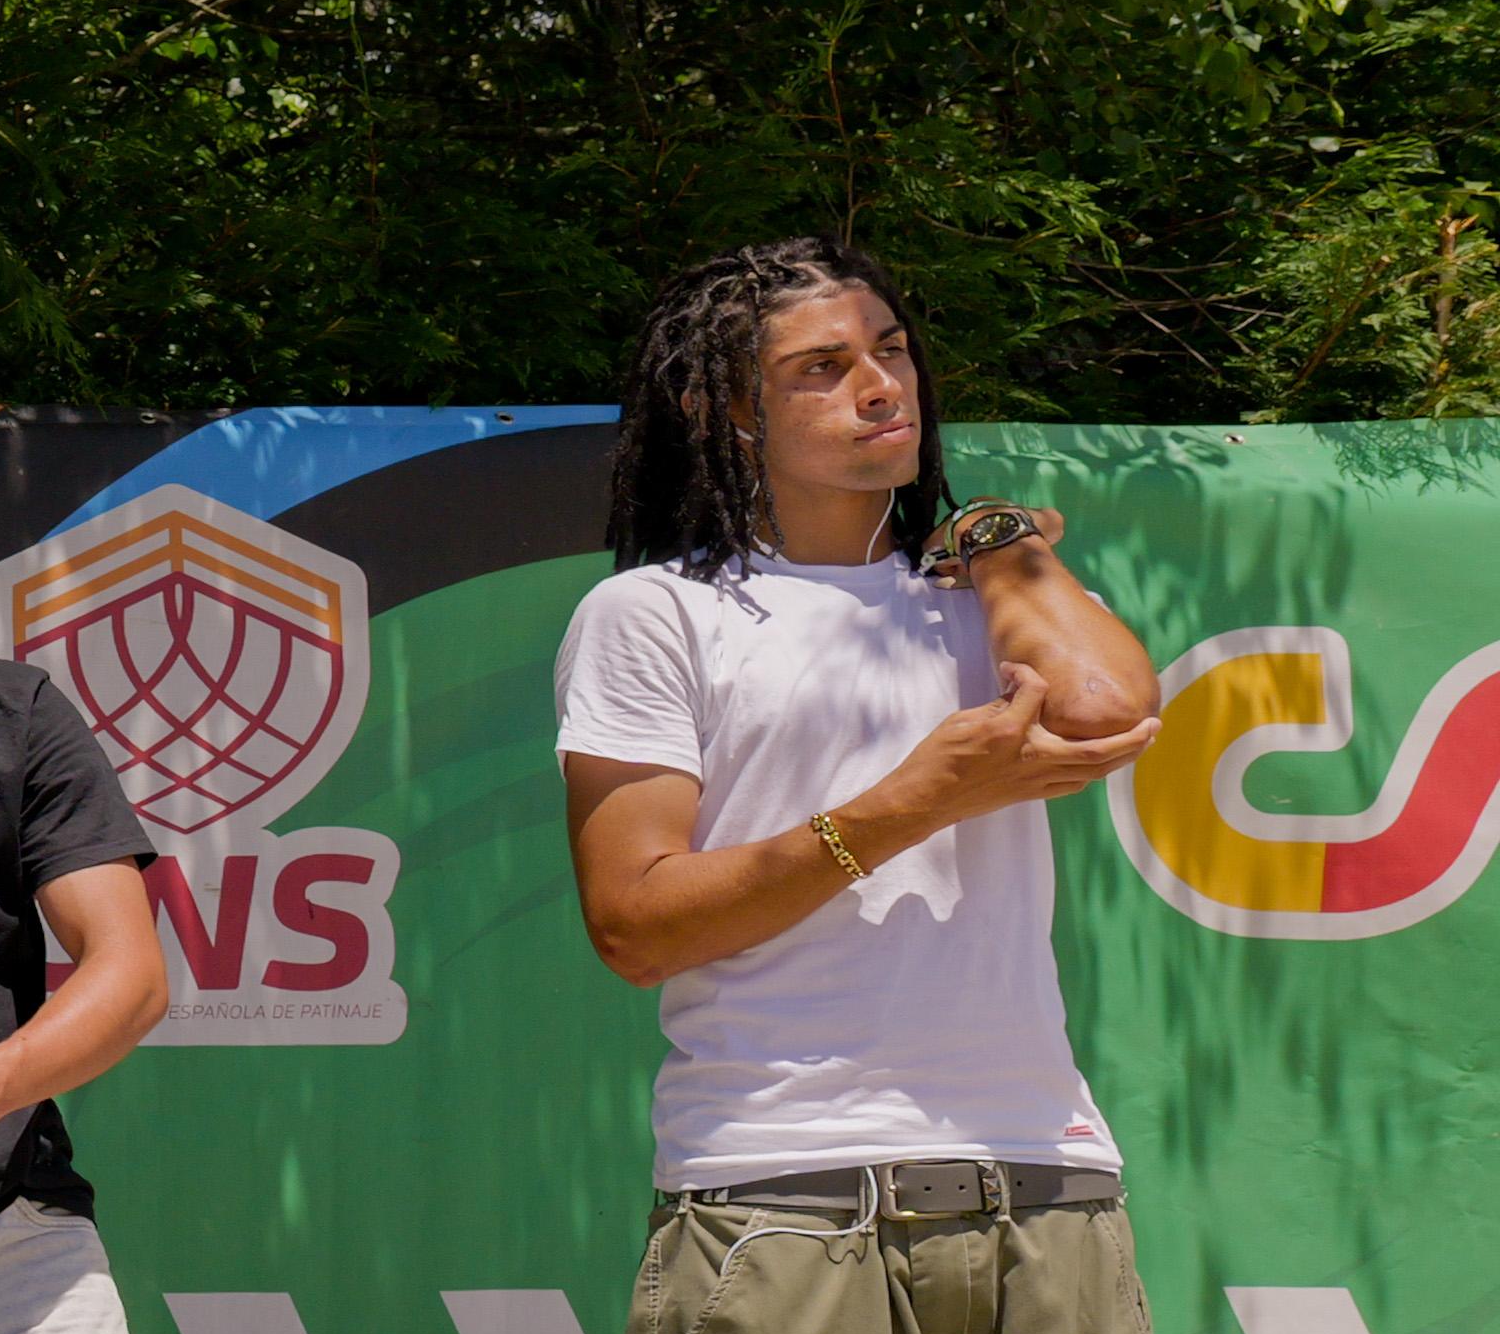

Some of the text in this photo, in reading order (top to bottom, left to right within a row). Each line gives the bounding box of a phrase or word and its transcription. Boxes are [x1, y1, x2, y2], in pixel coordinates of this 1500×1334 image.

[168, 1001, 383, 1020] ESPAÑOLA DE PATINAJE
